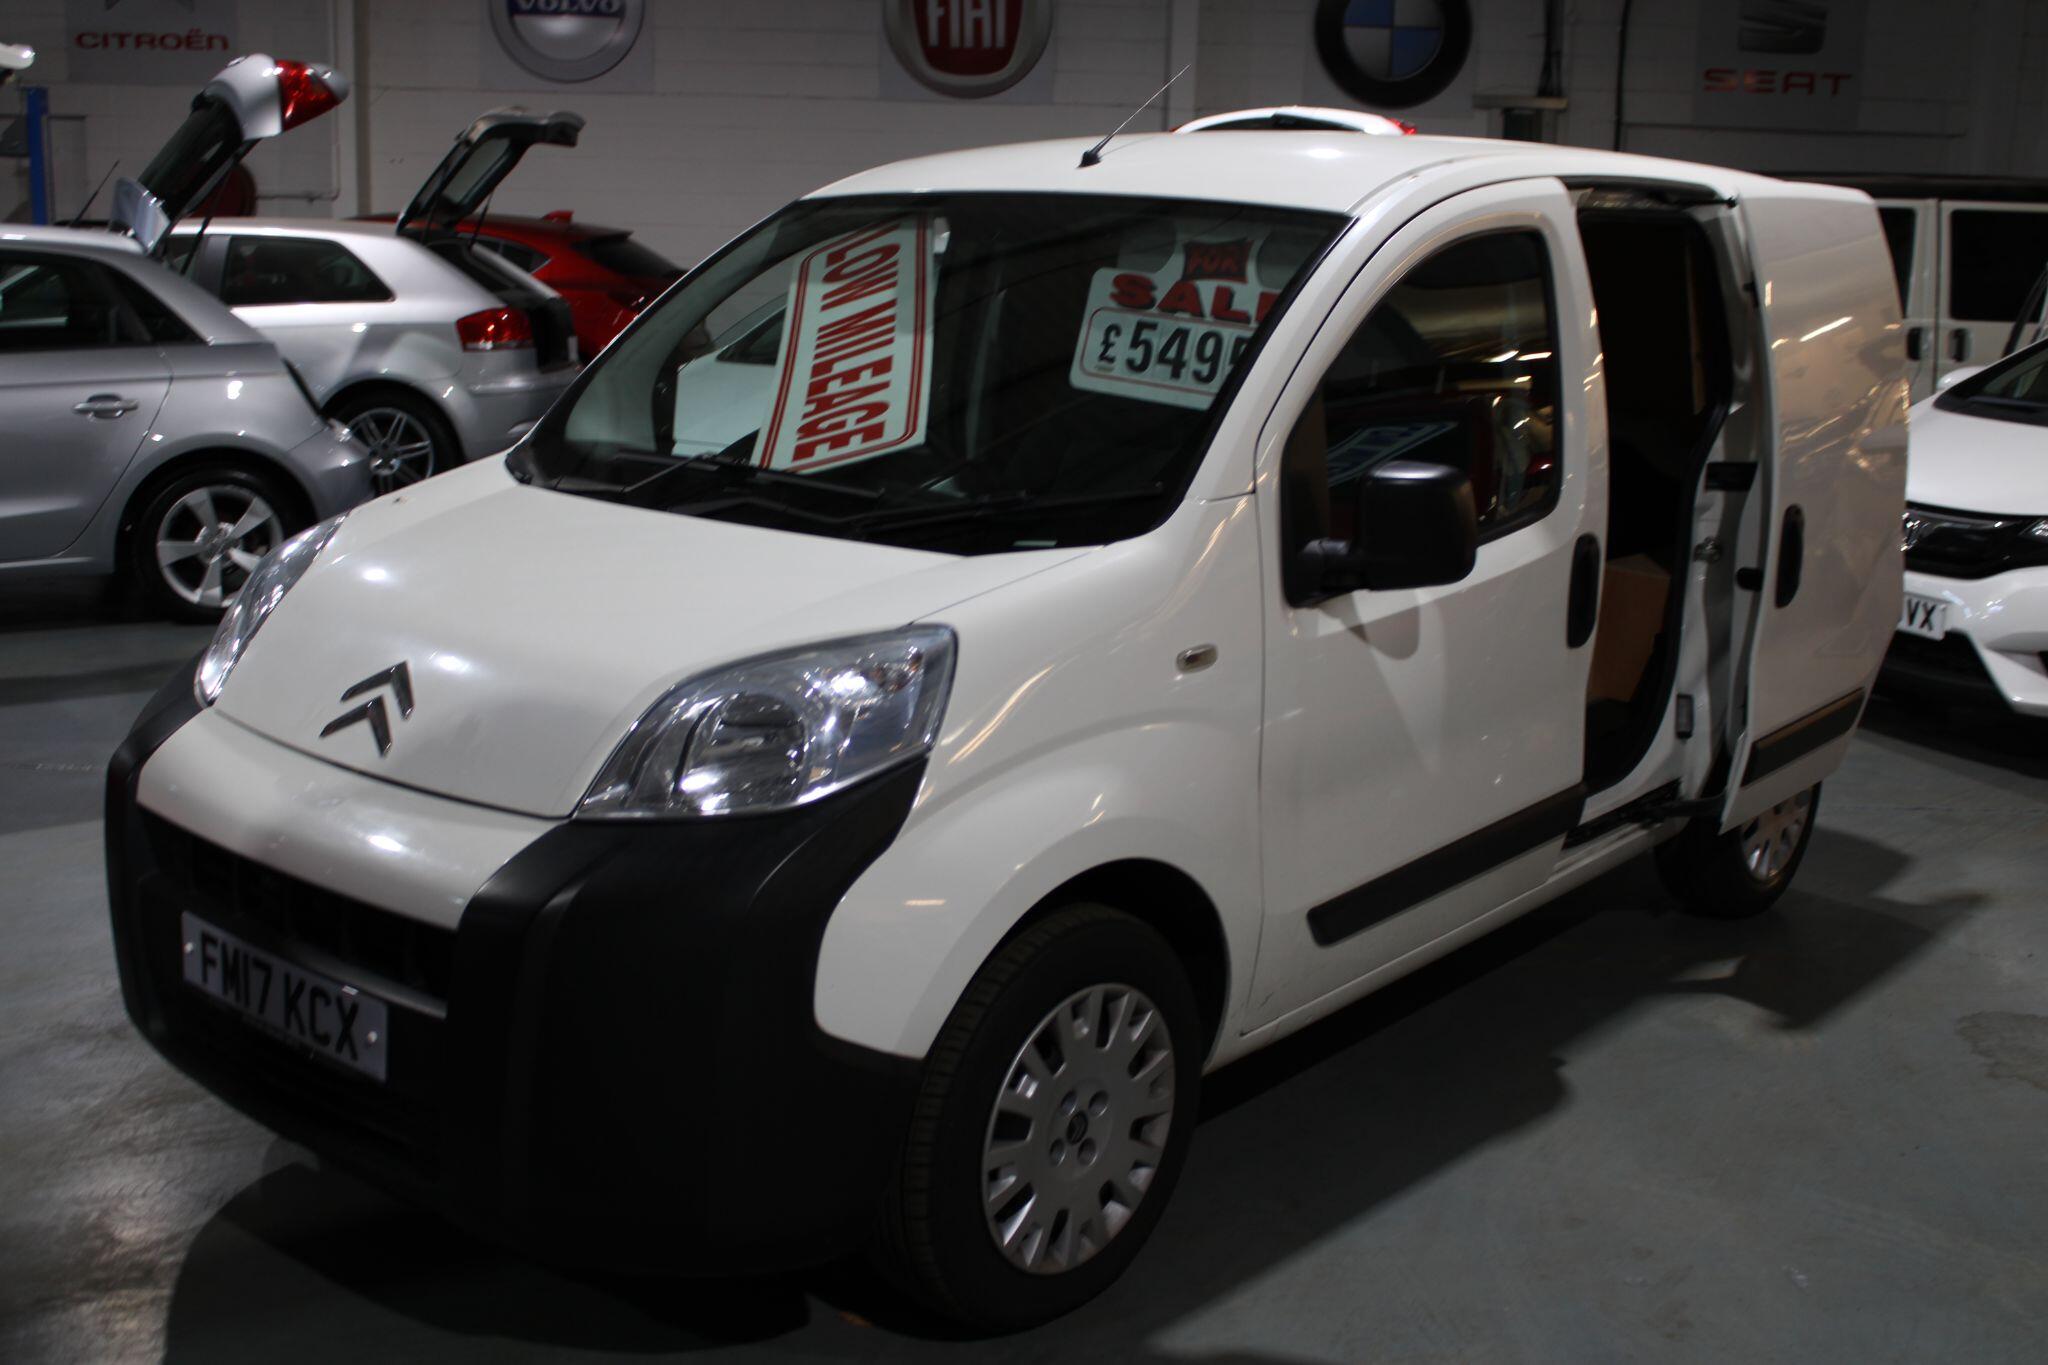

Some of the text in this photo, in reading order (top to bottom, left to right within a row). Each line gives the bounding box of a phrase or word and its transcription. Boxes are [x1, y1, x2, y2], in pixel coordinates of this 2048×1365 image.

[513, 0, 622, 13] VOLVO
[926, 0, 1007, 48] FIAT
[1703, 67, 1853, 97] SEAT
[792, 223, 901, 462] LOW MILEAGE
[202, 932, 359, 1061] FM17 KCX
